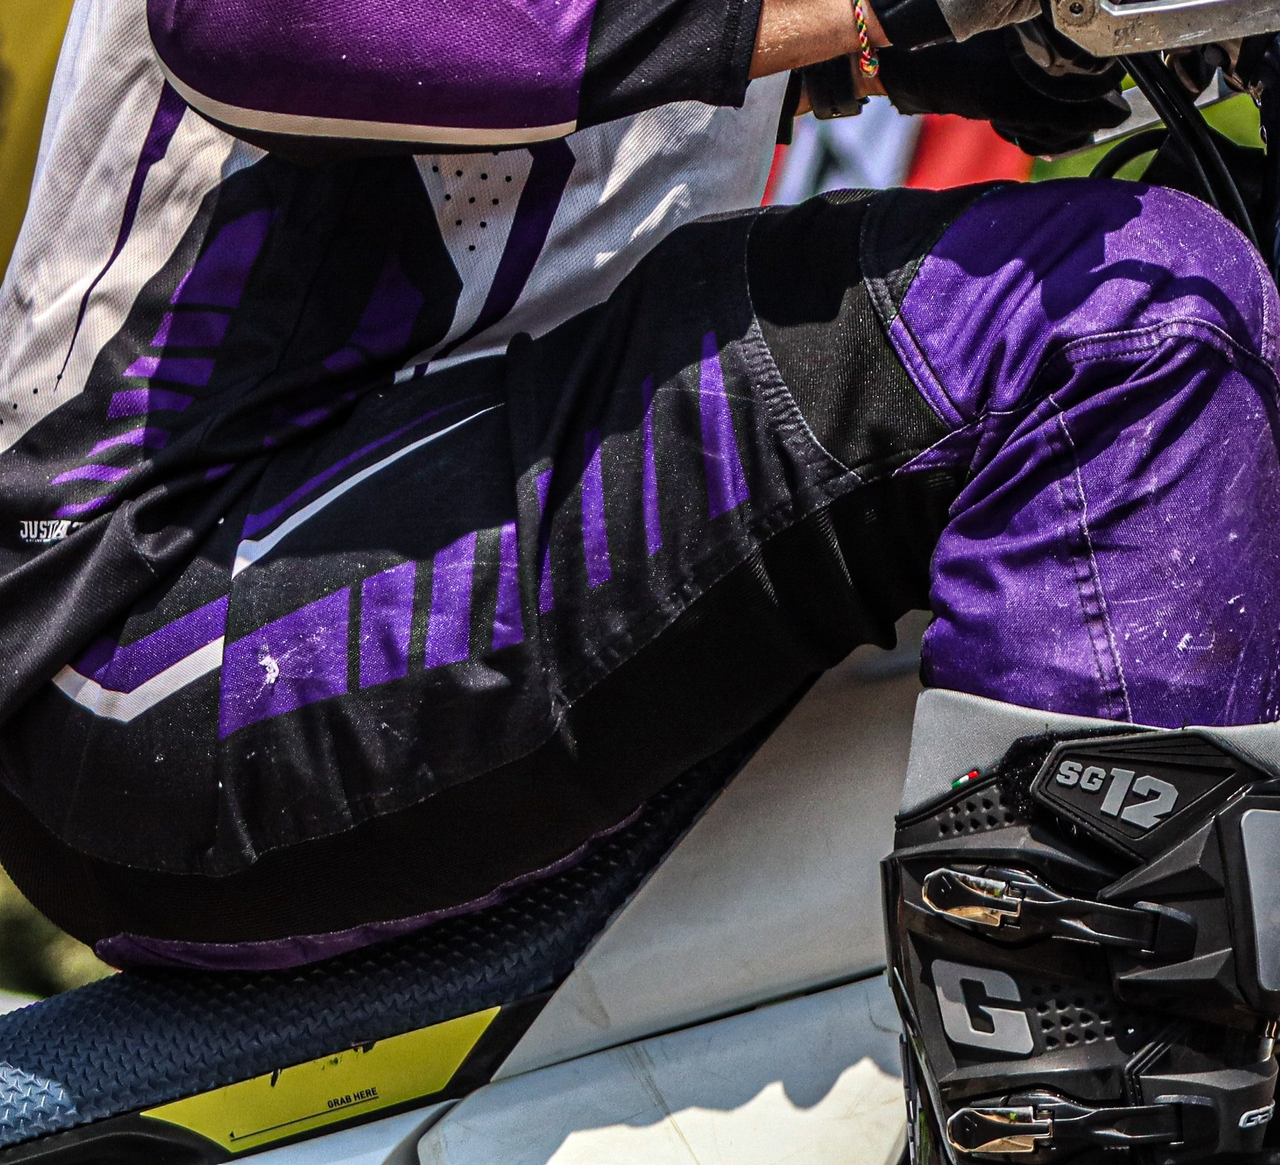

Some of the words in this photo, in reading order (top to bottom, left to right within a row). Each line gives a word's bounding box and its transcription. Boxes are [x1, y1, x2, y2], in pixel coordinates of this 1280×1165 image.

[931, 958, 1034, 1054] G
[327, 1094, 352, 1108] GRAB
[353, 1086, 378, 1101] HERE
